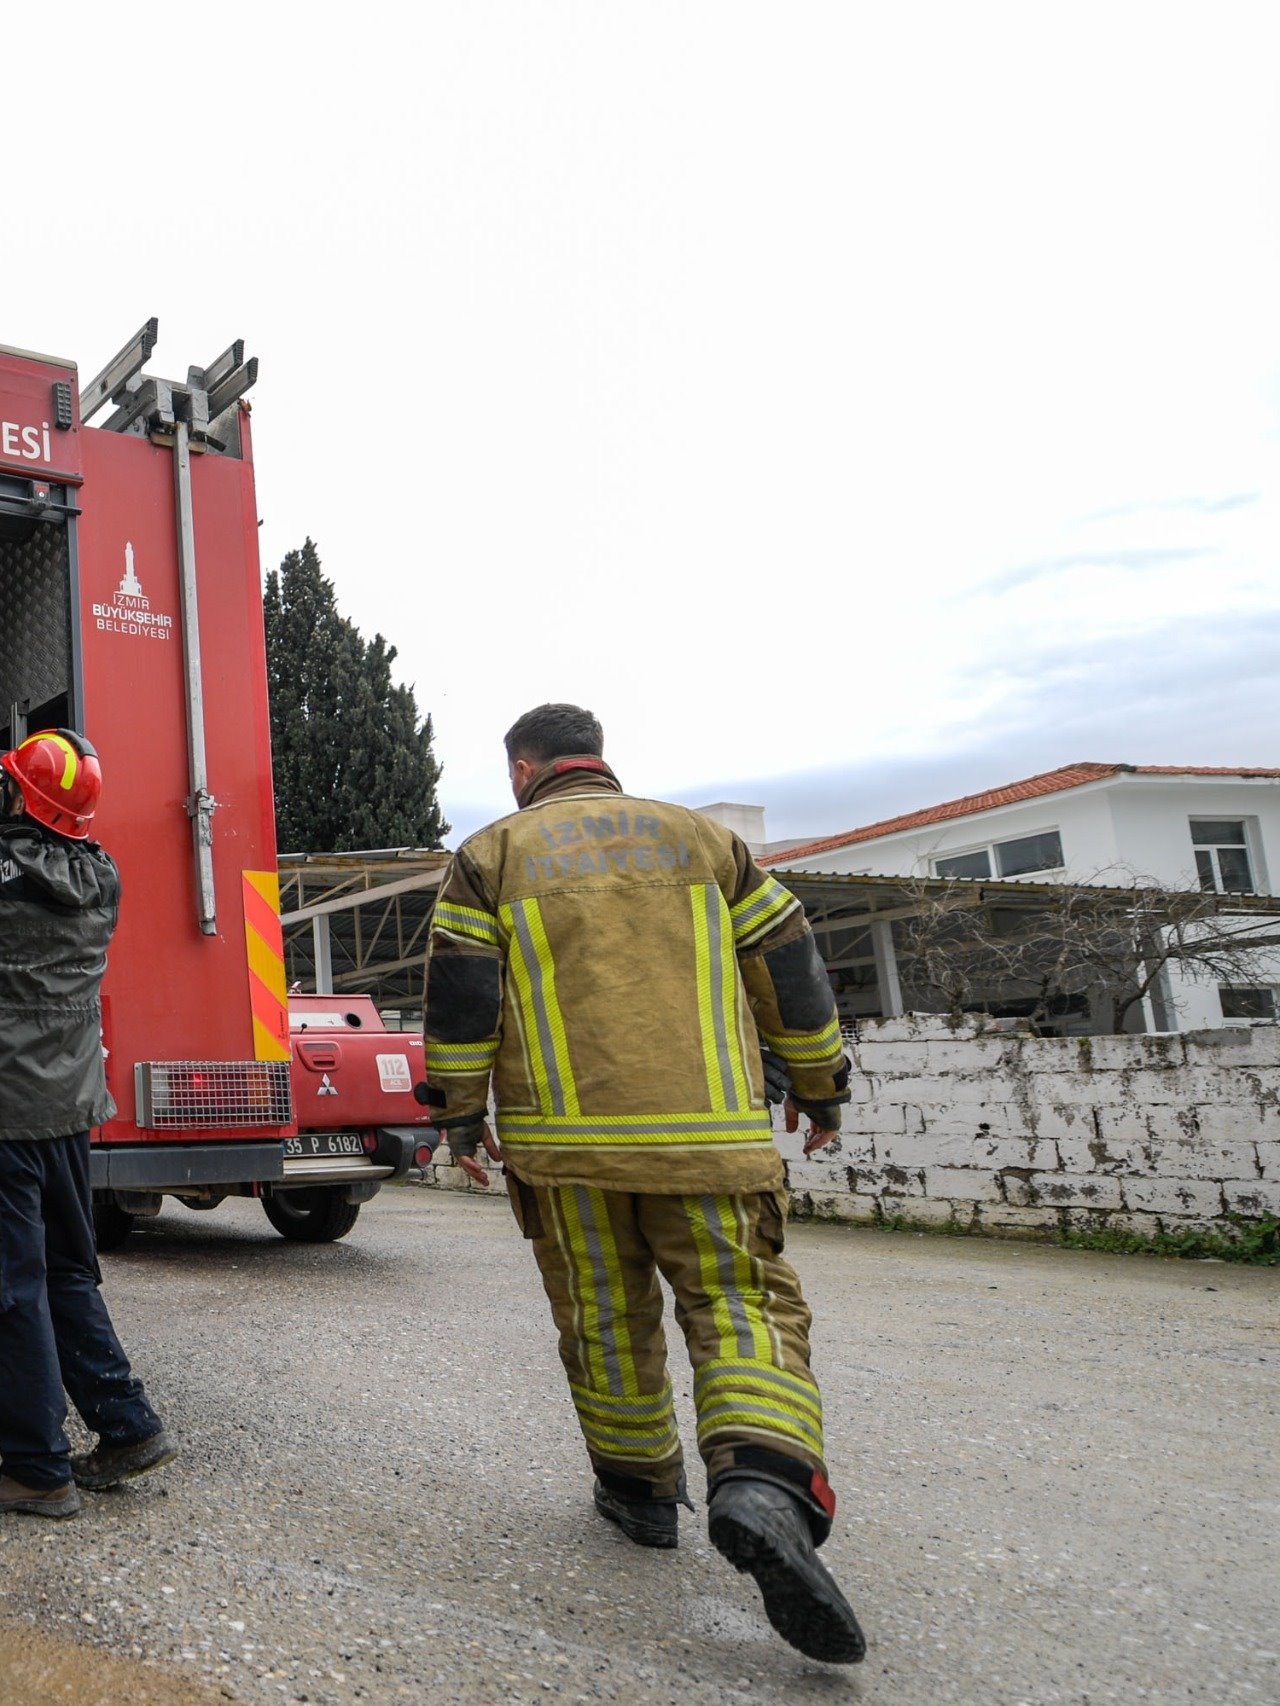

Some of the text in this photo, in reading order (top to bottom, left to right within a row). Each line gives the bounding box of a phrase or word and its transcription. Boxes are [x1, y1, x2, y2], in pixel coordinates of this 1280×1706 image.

[92, 603, 172, 628] BÜYÜKŞEHİR
[96, 618, 170, 640] BELEDİYESİ
[381, 1058, 405, 1076] 112
[286, 1136, 360, 1154] 35 P 6182
